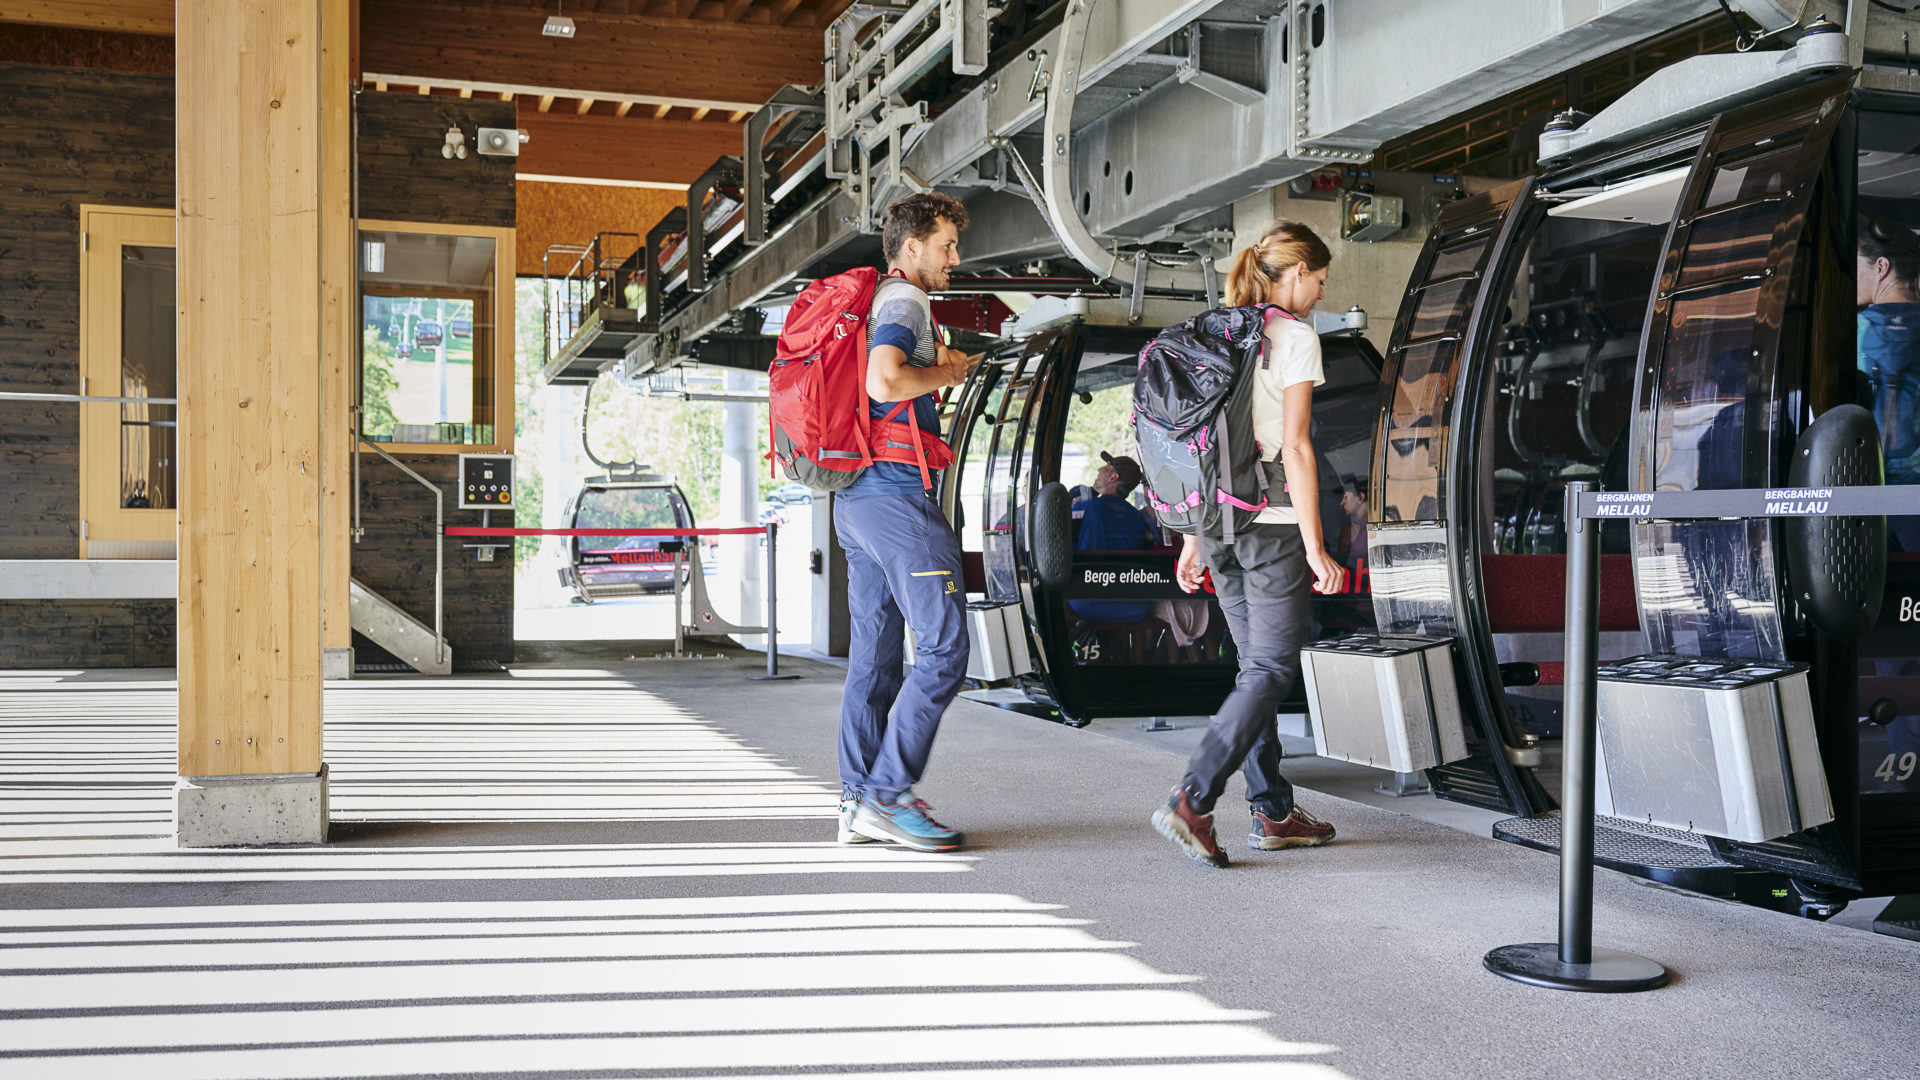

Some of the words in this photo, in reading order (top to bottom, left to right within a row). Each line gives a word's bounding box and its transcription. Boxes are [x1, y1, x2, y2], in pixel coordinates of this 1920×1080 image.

[1597, 494, 1654, 502] BERGBAHNEN
[1765, 489, 1832, 499] BERGBAHNEN
[1597, 504, 1651, 516] MELLAU
[1765, 501, 1829, 514] MELLAU
[1084, 570, 1116, 586] Berge
[1119, 569, 1169, 583] erleben...
[1082, 645, 1100, 660] 15
[1874, 752, 1917, 782] 49
